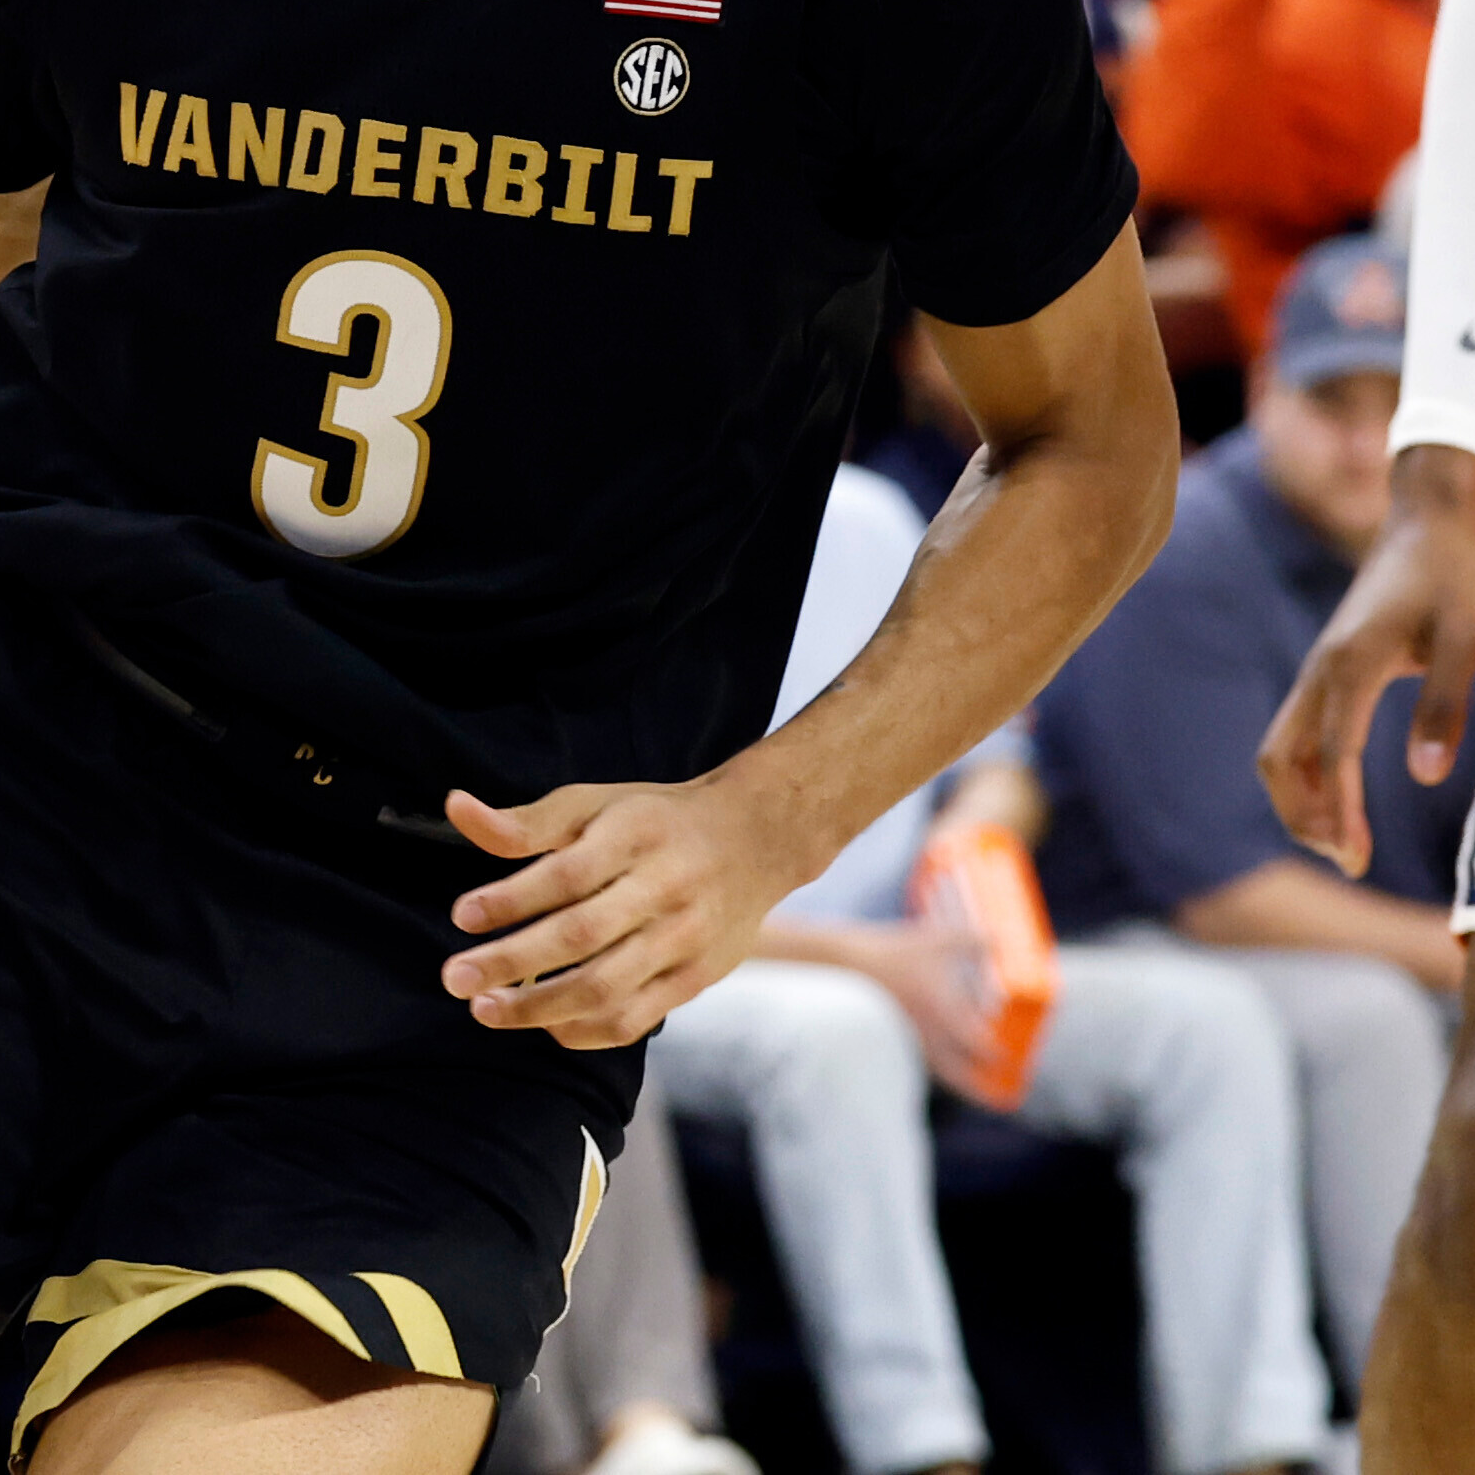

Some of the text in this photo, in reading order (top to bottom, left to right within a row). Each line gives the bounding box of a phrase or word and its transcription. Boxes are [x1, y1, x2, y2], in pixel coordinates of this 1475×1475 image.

[621, 44, 683, 109] SEC
[119, 82, 714, 237] VANDERBILT
[250, 248, 453, 559] 3
